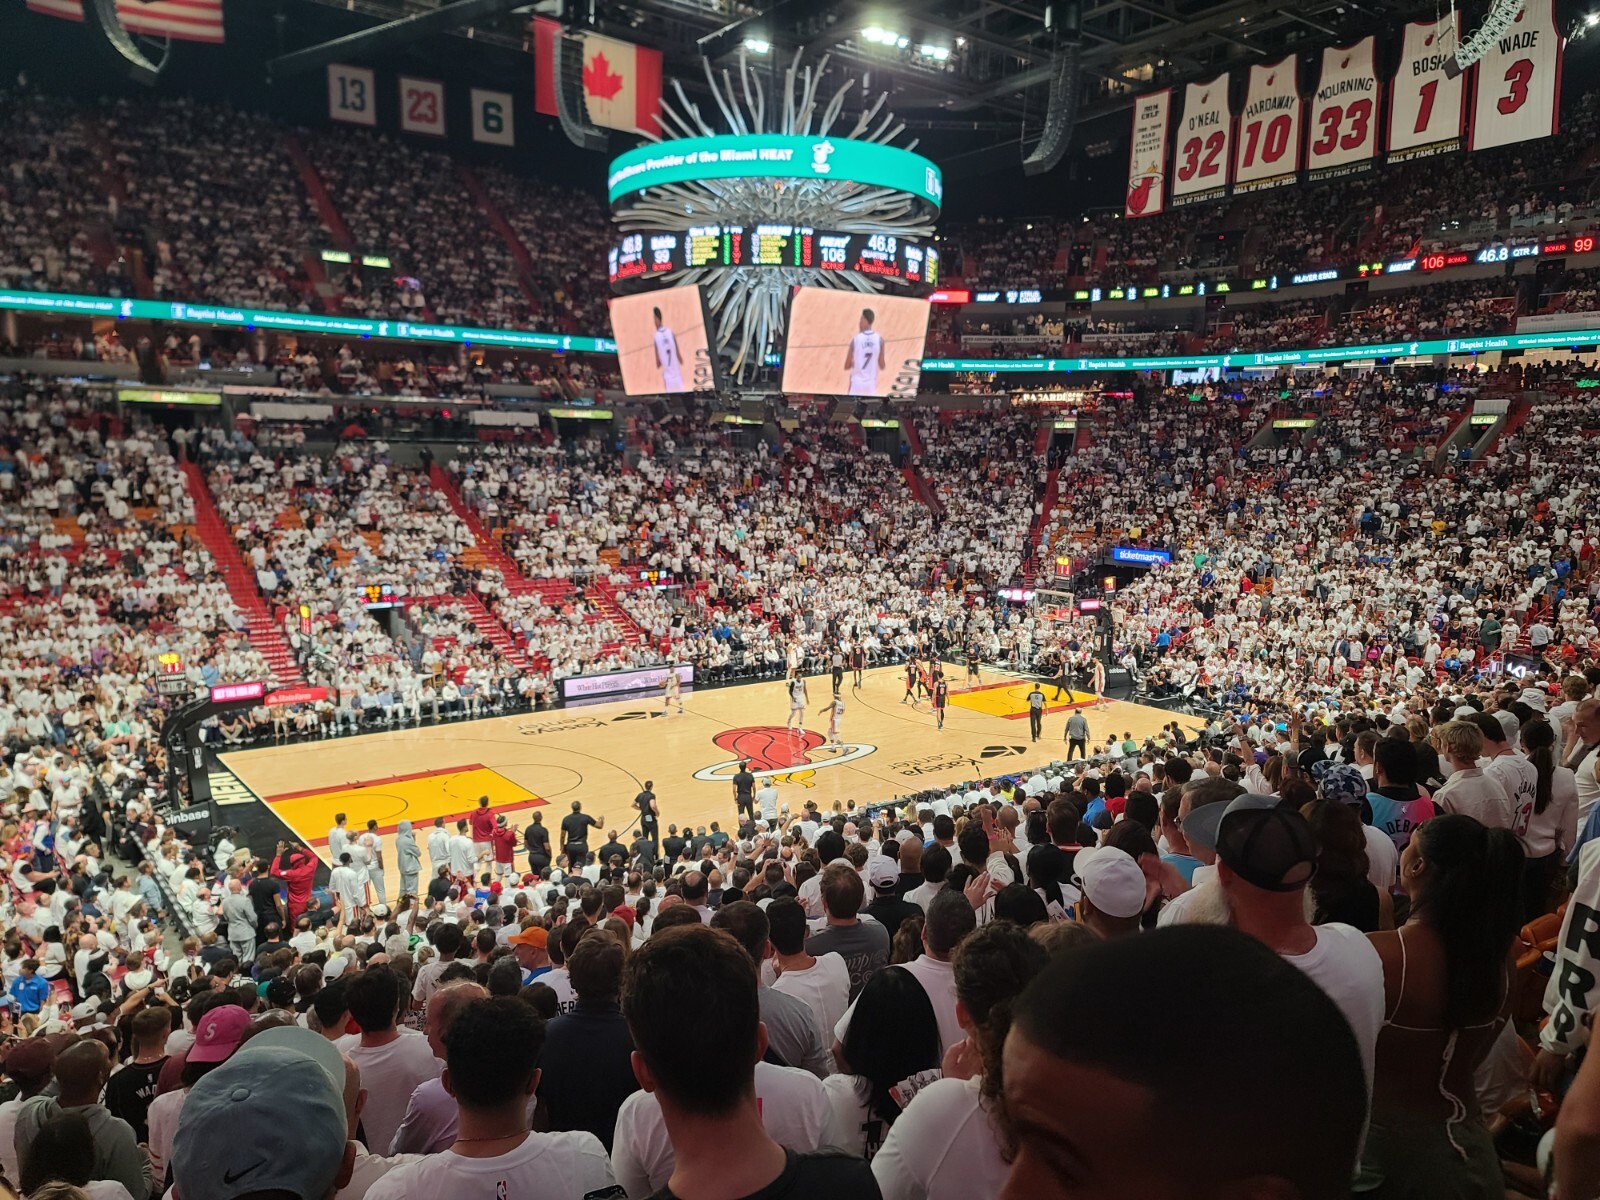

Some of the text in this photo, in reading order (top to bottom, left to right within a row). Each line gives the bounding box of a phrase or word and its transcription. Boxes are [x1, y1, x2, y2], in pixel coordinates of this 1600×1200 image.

[1499, 31, 1539, 55] WADE
[1413, 54, 1447, 76] BOSH
[338, 76, 366, 112] 13
[1317, 77, 1373, 103] MOURNING
[1497, 58, 1534, 115] 3
[407, 89, 438, 124] 23
[1246, 95, 1296, 119] HARDAWAY
[1413, 79, 1438, 134] 1
[482, 101, 503, 133] 6
[1189, 111, 1220, 131] O'NEAL
[1312, 98, 1373, 156] 33
[1242, 114, 1292, 168] 10
[647, 149, 793, 171] Provider of the Miami HEAT
[1178, 130, 1225, 182] 32
[1387, 156, 1404, 164] HALL
[1416, 149, 1435, 159] FAME
[820, 235, 851, 248] HEAT
[868, 234, 897, 254] 46.8
[1544, 244, 1566, 253] BONUS
[1574, 238, 1593, 252] 99
[821, 248, 846, 263] 106
[861, 249, 888, 260] QUARTER
[1422, 256, 1444, 269] 106
[1478, 245, 1539, 262] 46.8 QTR 4
[821, 261, 845, 270] BONUS
[1388, 258, 1416, 273] HEAT
[1294, 270, 1338, 284] PLAYER STATS
[976, 292, 1000, 302] HEAT
[1460, 339, 1508, 350] Baptist Health
[862, 352, 873, 370] 7
[1089, 361, 1107, 369] Baptist
[1264, 353, 1301, 363] Baptist Health
[517, 716, 608, 736] Kaseya Center
[887, 753, 984, 777] Kaseya Center
[204, 1023, 217, 1040] S
